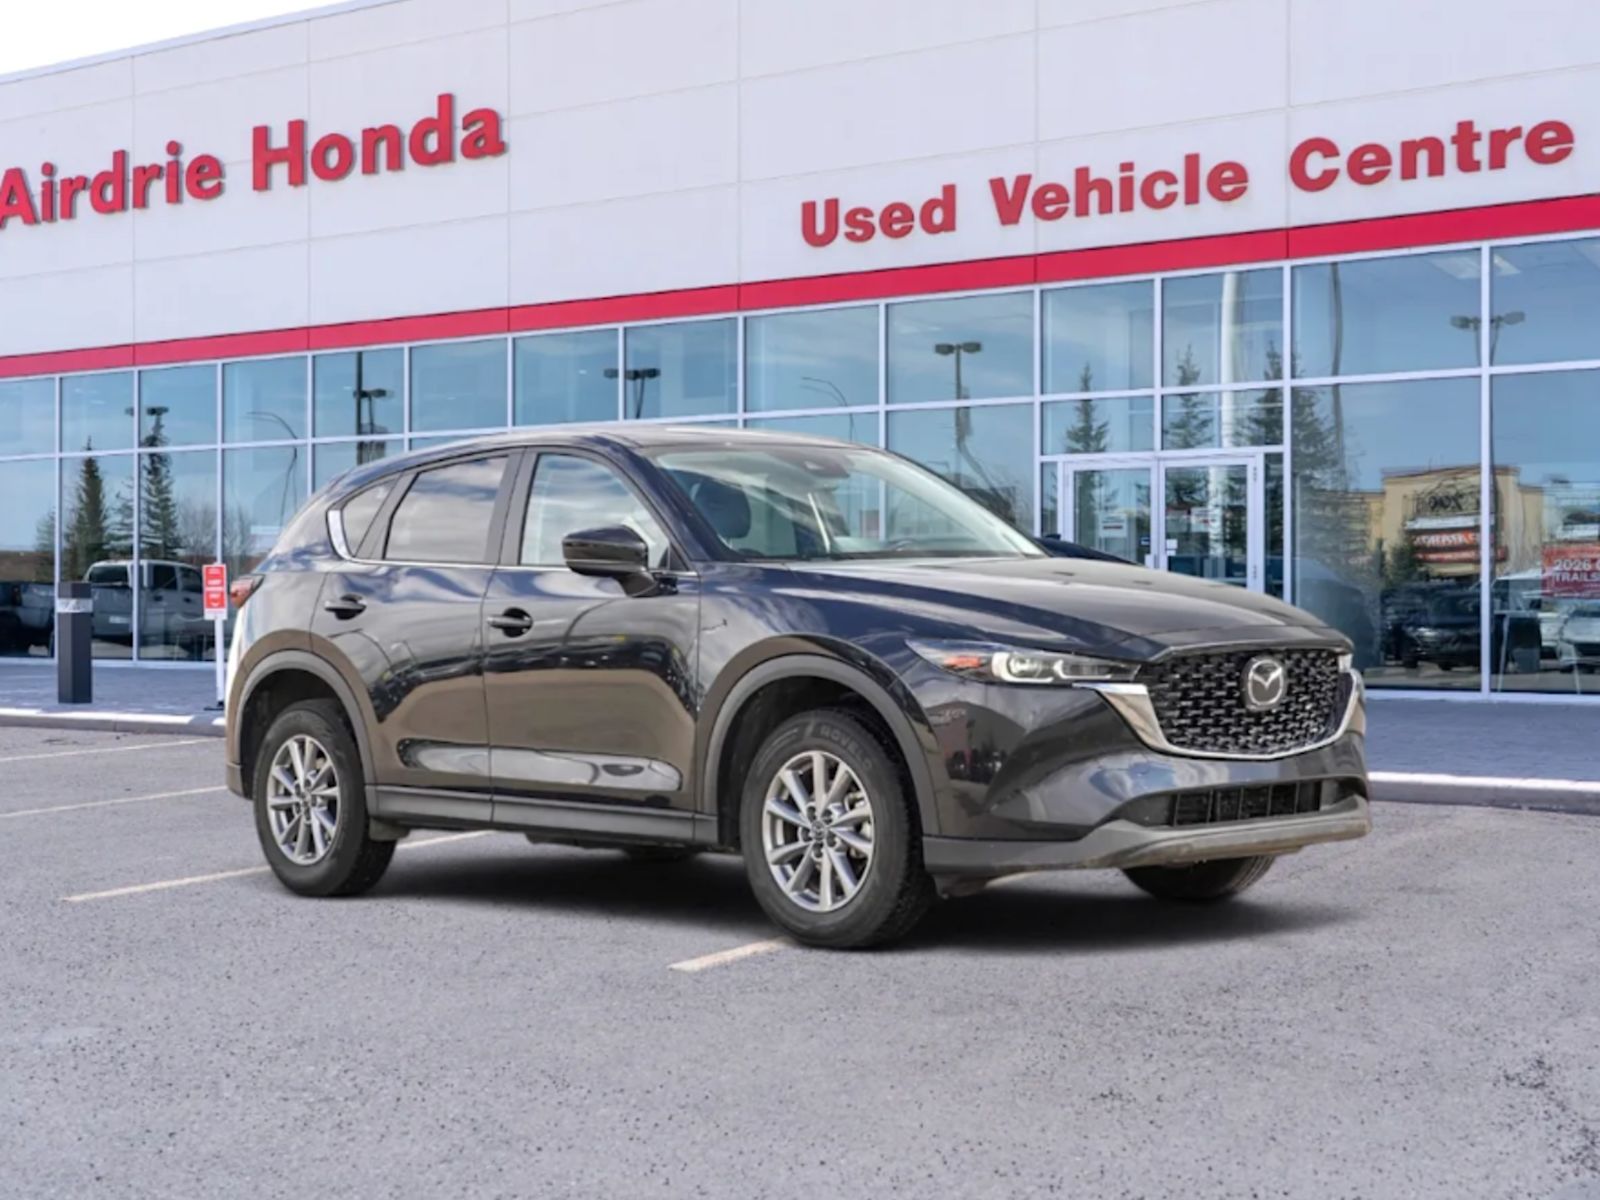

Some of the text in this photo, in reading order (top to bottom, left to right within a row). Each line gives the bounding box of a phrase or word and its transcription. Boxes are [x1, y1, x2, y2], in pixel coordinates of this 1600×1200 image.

[0, 92, 506, 227] Airdrie Honda
[801, 119, 1575, 247] Used Vehicle Centre
[1554, 558, 1591, 571] 2026
